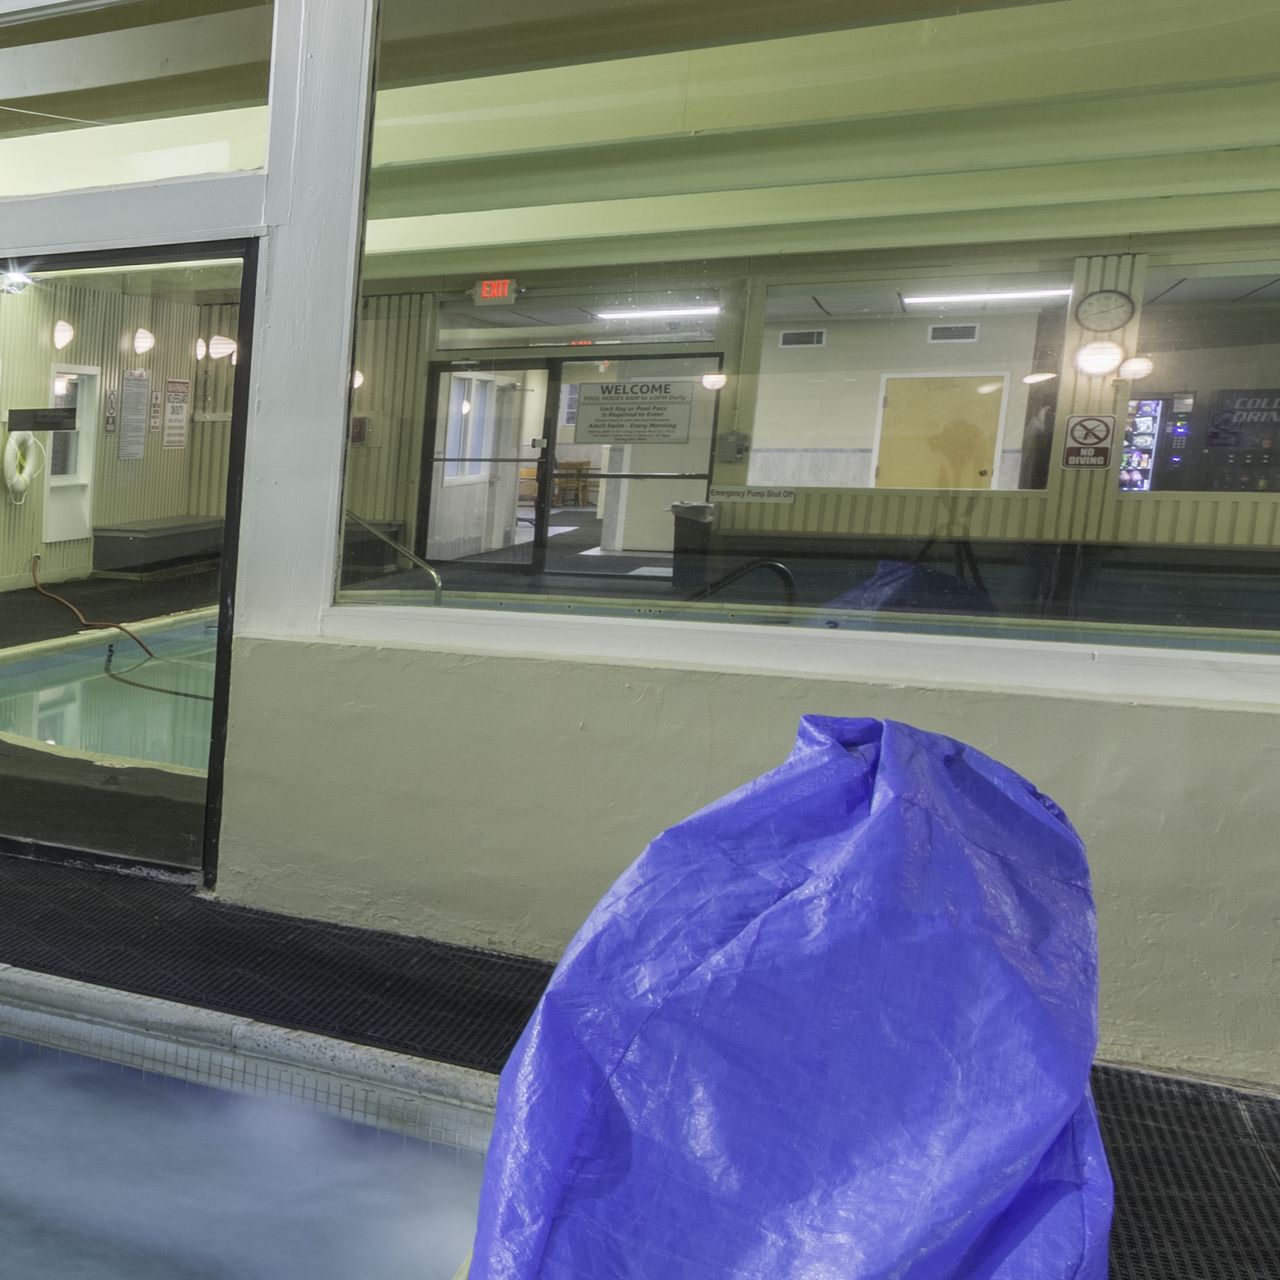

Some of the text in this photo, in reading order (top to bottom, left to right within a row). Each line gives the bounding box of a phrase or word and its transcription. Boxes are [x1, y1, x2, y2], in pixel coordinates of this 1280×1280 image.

[481, 279, 511, 299] EXIT
[600, 384, 672, 395] WELCOME
[1080, 448, 1095, 456] NO
[1068, 456, 1105, 465] DIVING
